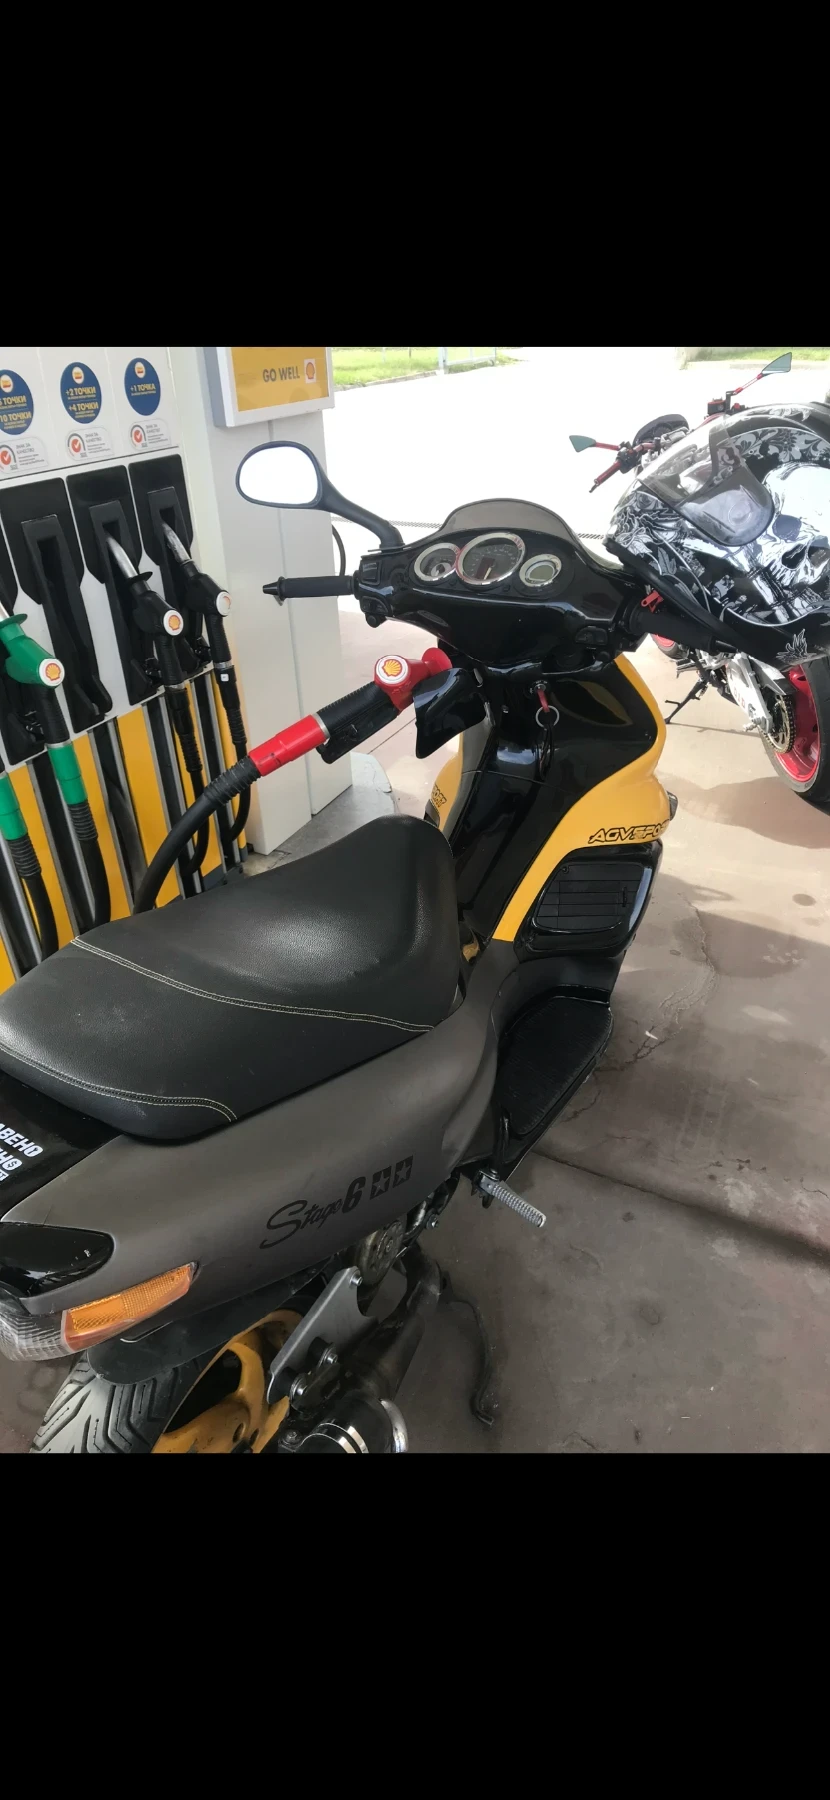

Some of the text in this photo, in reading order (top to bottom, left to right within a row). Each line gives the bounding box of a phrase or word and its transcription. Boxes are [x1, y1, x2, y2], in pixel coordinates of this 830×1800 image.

[262, 365, 301, 383] GO WELL
[65, 387, 96, 396] +2 ТОЧКИ
[137, 383, 156, 391] ТОЧКА
[3, 395, 27, 405] ТОЧКИ
[68, 401, 99, 412] +4 ТОЧКИ
[8, 411, 32, 421] ТОЧКИ
